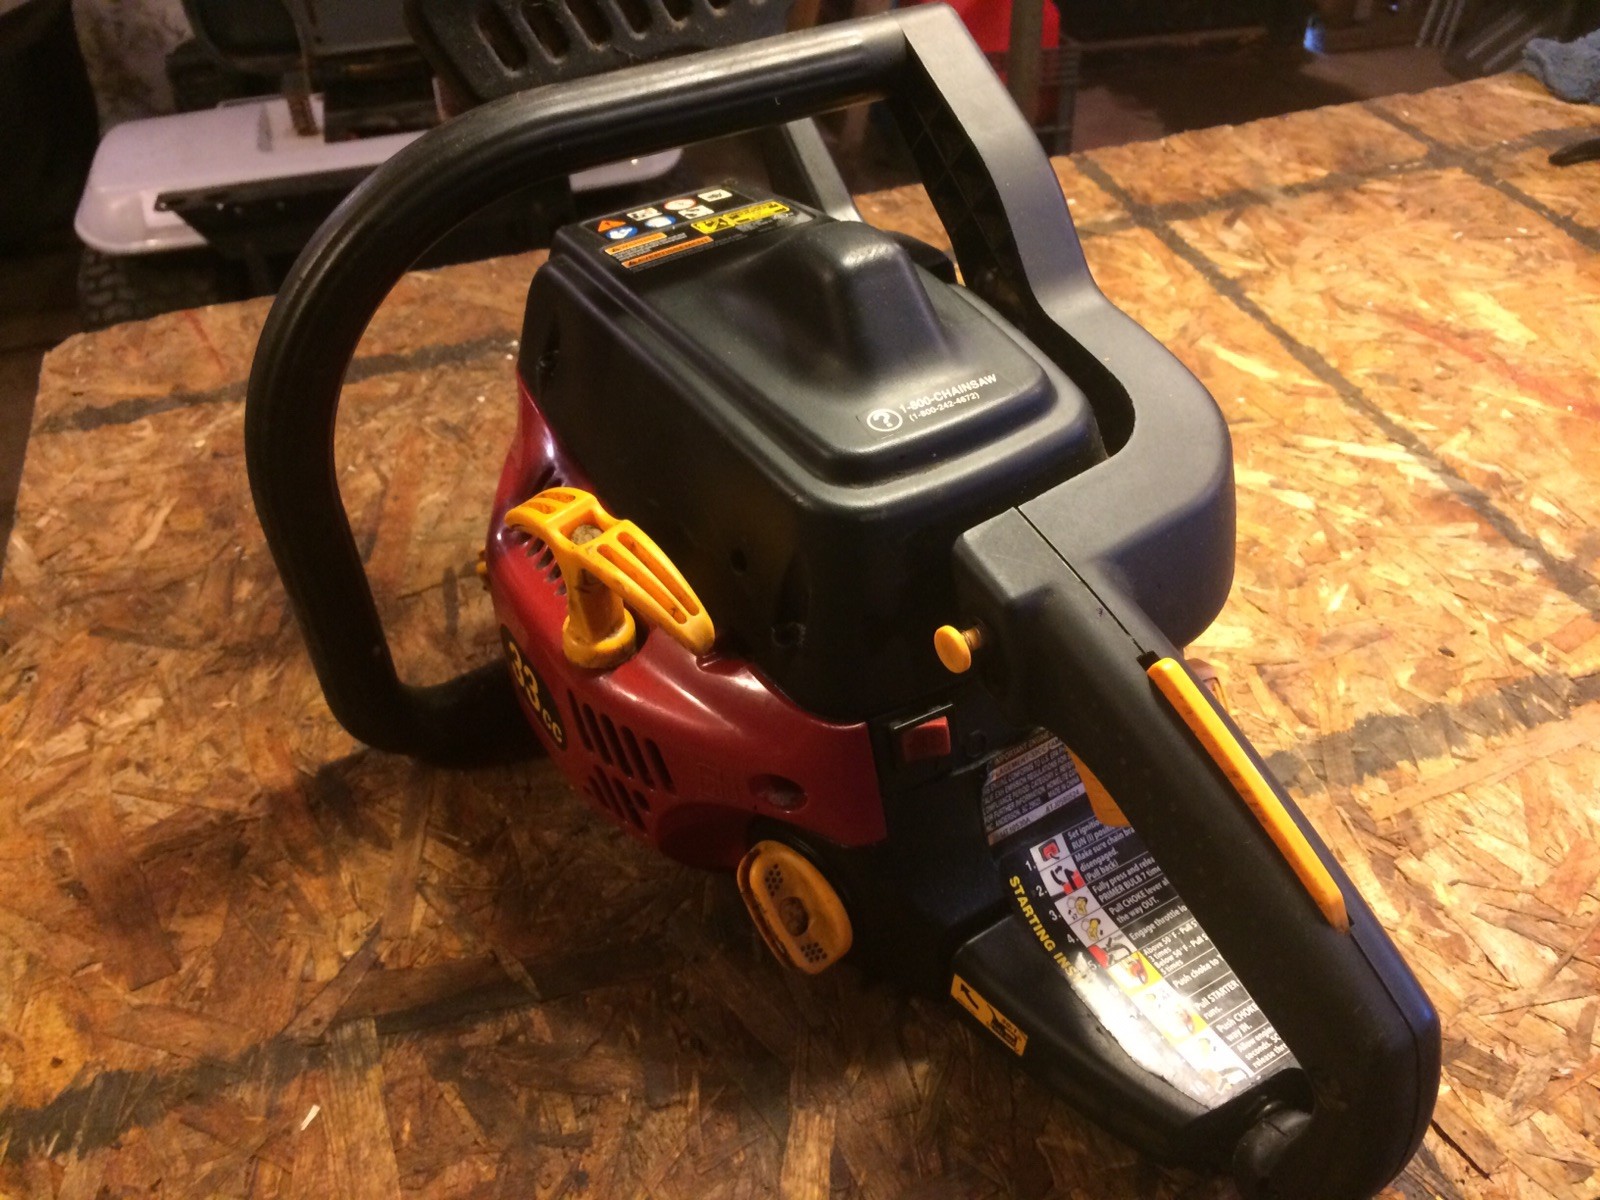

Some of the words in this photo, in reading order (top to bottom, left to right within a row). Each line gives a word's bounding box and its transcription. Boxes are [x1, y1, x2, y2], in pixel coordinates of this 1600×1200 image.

[899, 373, 997, 414] 1-800-CHAINSAW
[1067, 829, 1079, 838] Set
[1072, 837, 1087, 849] RUN
[1075, 848, 1092, 860] Make
[1093, 842, 1106, 851] sure
[1106, 831, 1123, 844] chain
[1026, 861, 1035, 870] 1.
[1079, 848, 1118, 872] disengaged.
[1036, 884, 1046, 895] 2.
[1093, 880, 1109, 893] Fully
[1110, 872, 1127, 884] press
[1126, 864, 1138, 874] and
[1098, 884, 1124, 902] PRIMER
[1123, 875, 1141, 888] BULB
[1109, 903, 1123, 914] Pull
[1122, 890, 1145, 906] CHOKE
[1145, 881, 1161, 894] lever
[1117, 913, 1128, 923] the
[1128, 906, 1143, 918] way
[1141, 895, 1159, 909] OUT.
[1009, 876, 1055, 953] STARTING
[1049, 908, 1060, 920] 3.
[1129, 922, 1156, 941] Engage
[1154, 907, 1180, 926] throttle
[1066, 932, 1077, 943] 4.
[1143, 941, 1163, 955] Above
[1180, 923, 1192, 934] Pull
[1153, 946, 1171, 959] times
[1154, 954, 1174, 968] Below
[1190, 936, 1203, 947] Pull
[1165, 959, 1183, 971] times
[1172, 973, 1192, 988] Push
[1190, 962, 1211, 978] choke
[1209, 957, 1219, 966] to
[1196, 997, 1209, 1009] Pull
[1207, 979, 1240, 1002] STARTER
[1204, 1005, 1222, 1019] runs.
[1216, 1017, 1236, 1033] Push
[1225, 1029, 1242, 1043] way
[1239, 1020, 1252, 1032] IN.
[1236, 1037, 1255, 1052] Allow
[1244, 1040, 1273, 1060] seconds.
[1251, 1050, 1276, 1068] release
